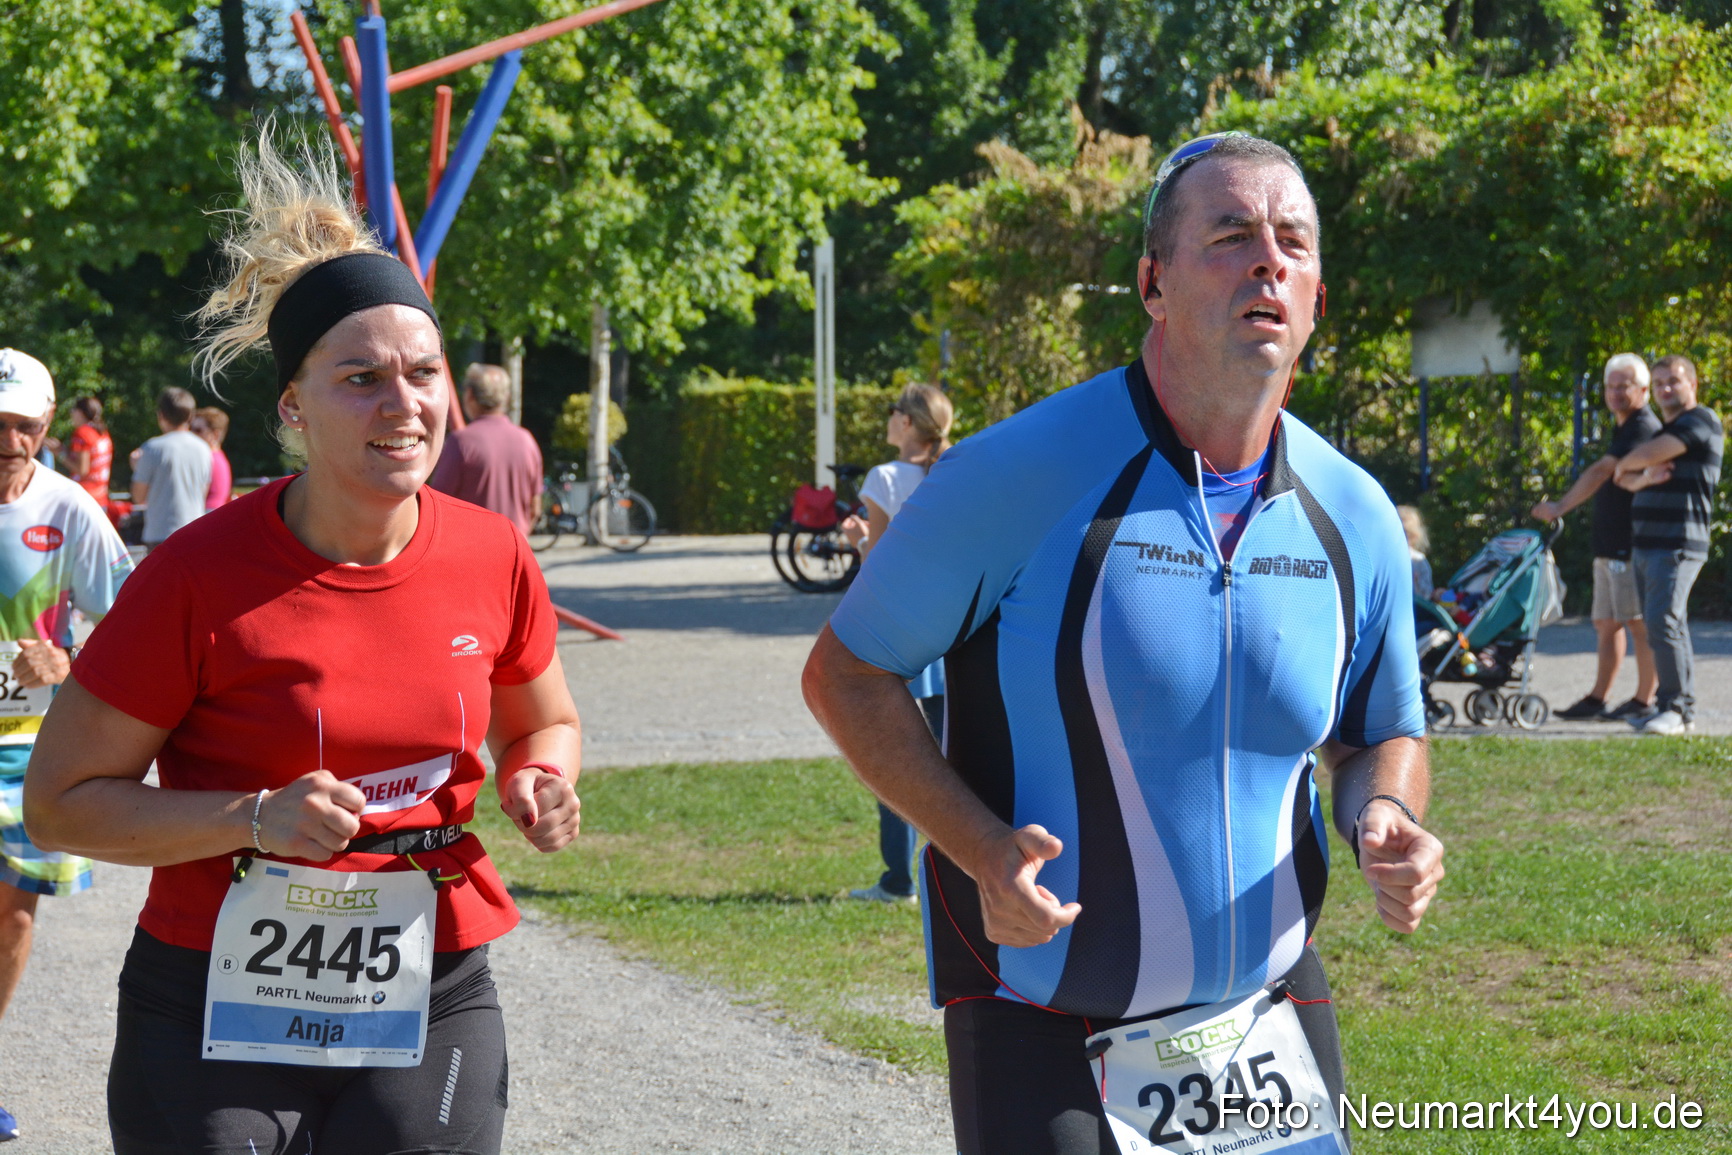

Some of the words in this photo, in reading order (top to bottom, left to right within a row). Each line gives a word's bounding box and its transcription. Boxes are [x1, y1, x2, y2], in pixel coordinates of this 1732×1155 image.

[1136, 565, 1204, 579] NEUMARKT
[1292, 558, 1328, 579] RACER
[362, 776, 419, 801] DEHN
[287, 884, 379, 910] BOCK
[285, 905, 315, 914] inspired
[349, 909, 378, 917] concepts
[245, 918, 401, 983] 2445
[223, 959, 232, 970] B
[256, 985, 302, 1001] PARTL
[305, 990, 367, 1005] Neumarkt
[286, 1015, 344, 1047] Anja
[1155, 1018, 1243, 1061] BOCK
[1160, 1057, 1190, 1069] inspired
[1191, 1055, 1200, 1063] by
[1201, 1049, 1219, 1059] smart
[1137, 1050, 1293, 1146] 2345
[1213, 1129, 1274, 1155] Neumarkt
